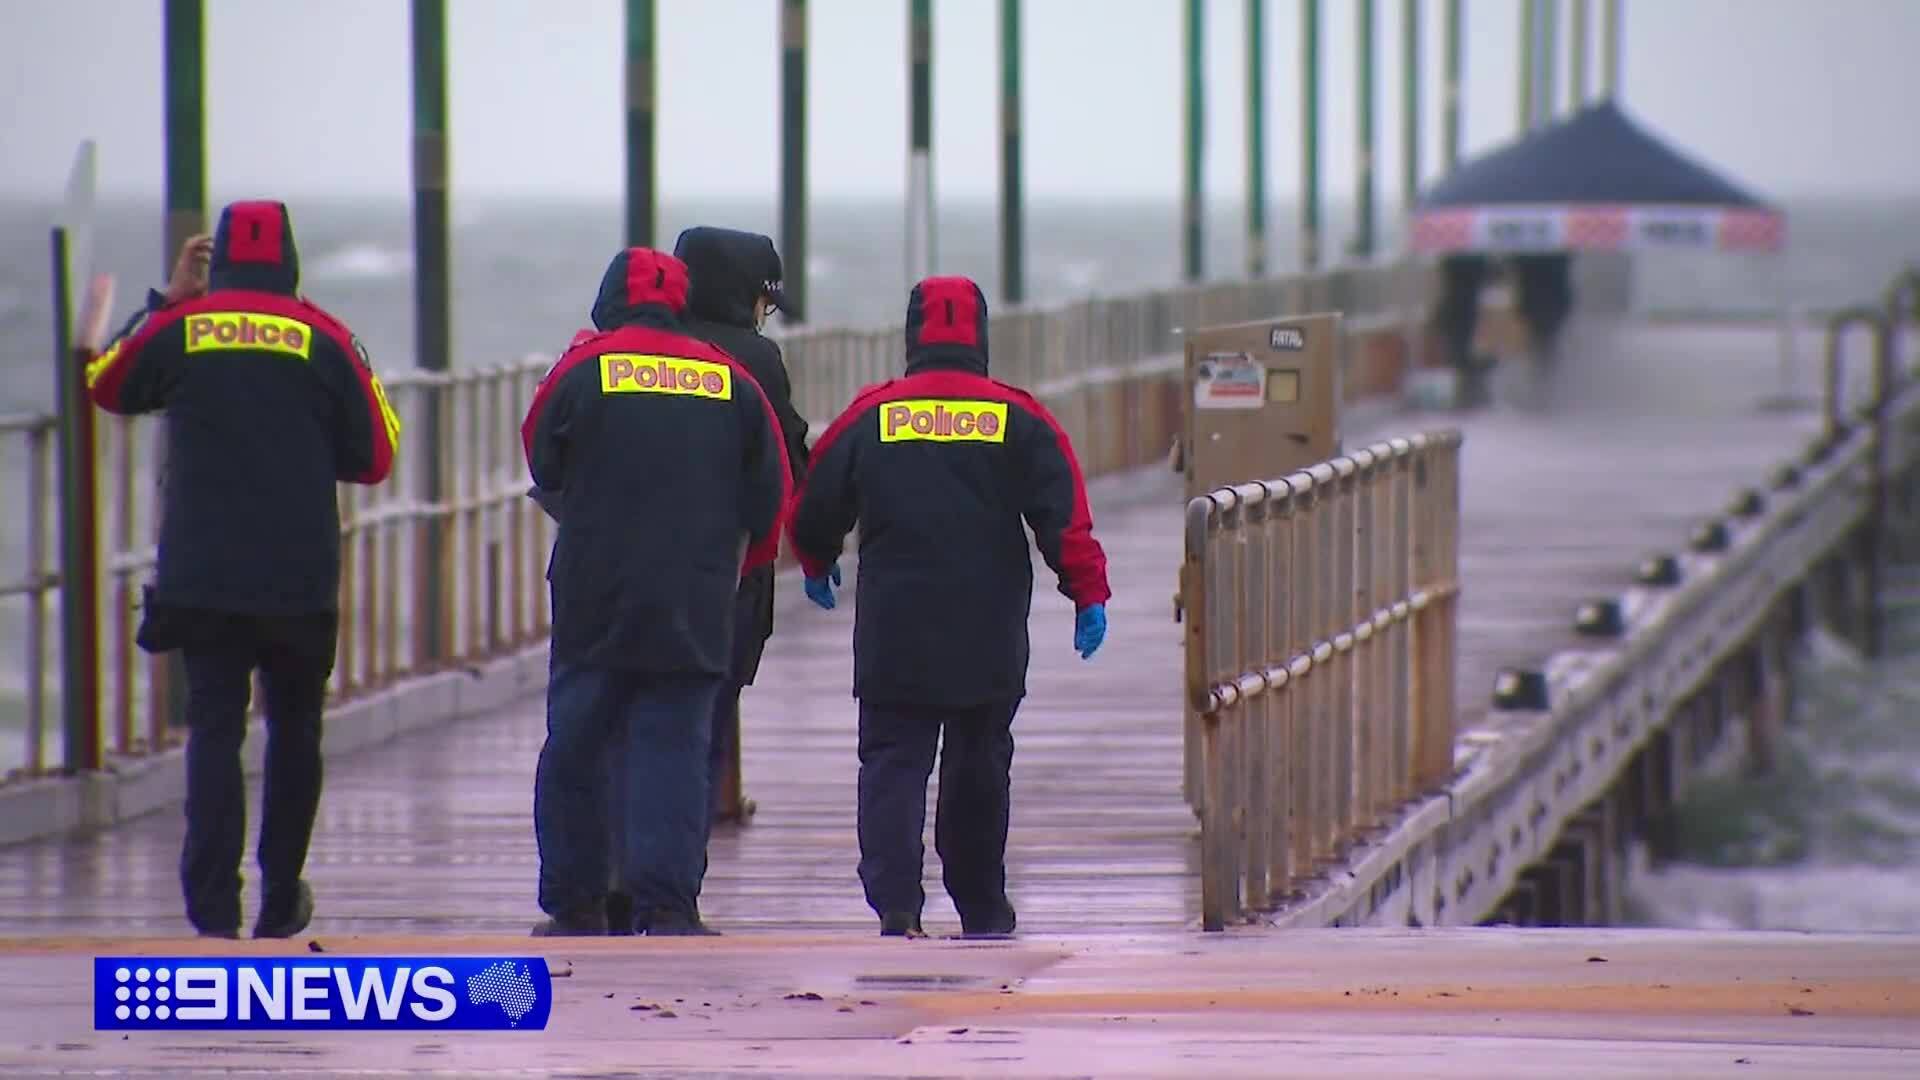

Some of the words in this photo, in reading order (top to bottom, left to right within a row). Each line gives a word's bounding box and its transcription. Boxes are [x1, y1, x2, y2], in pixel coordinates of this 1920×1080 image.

[189, 315, 304, 350] Police
[608, 358, 724, 394] Police
[887, 404, 999, 436] Police
